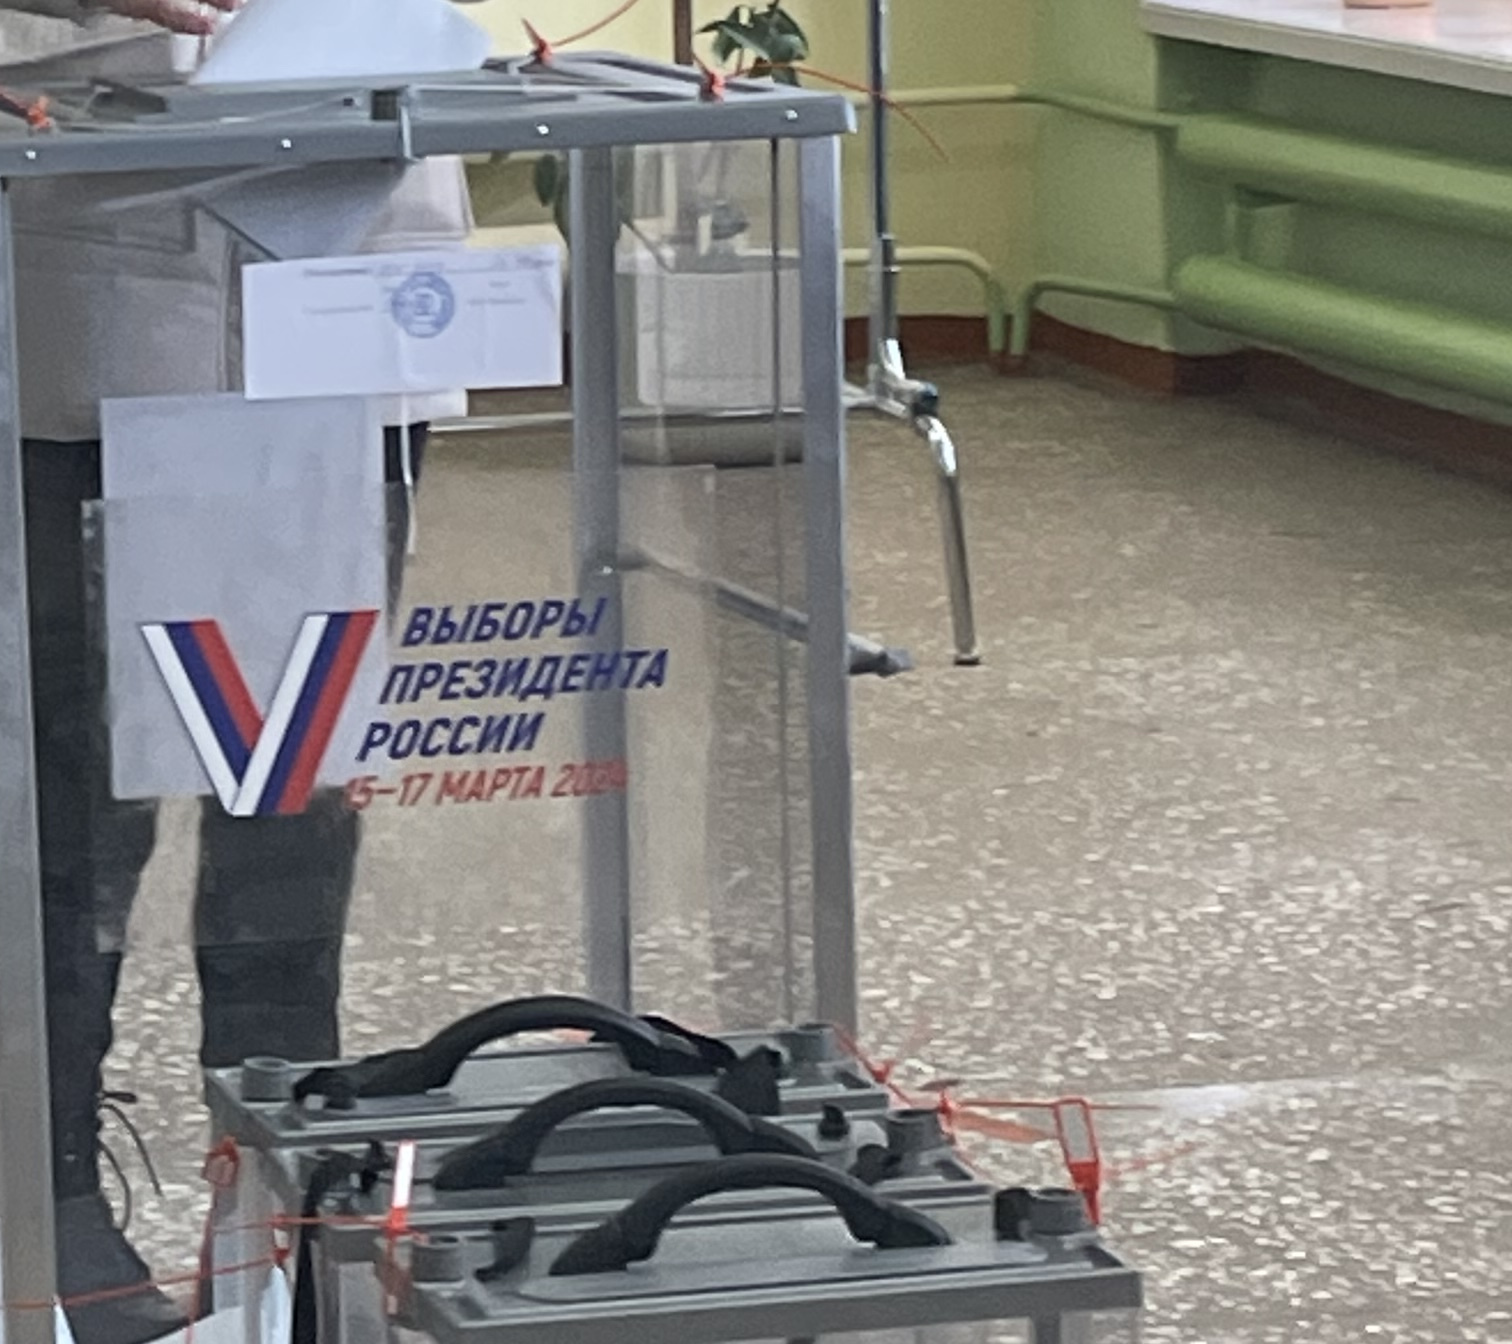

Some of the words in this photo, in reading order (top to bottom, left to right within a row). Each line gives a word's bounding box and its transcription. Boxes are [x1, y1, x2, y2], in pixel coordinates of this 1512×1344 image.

[402, 598, 606, 647] ВЫБОРЫ
[380, 650, 669, 703] ПРЕЗИДЕНТА
[356, 713, 546, 761] РОССИИ
[437, 766, 544, 805] МАРТА
